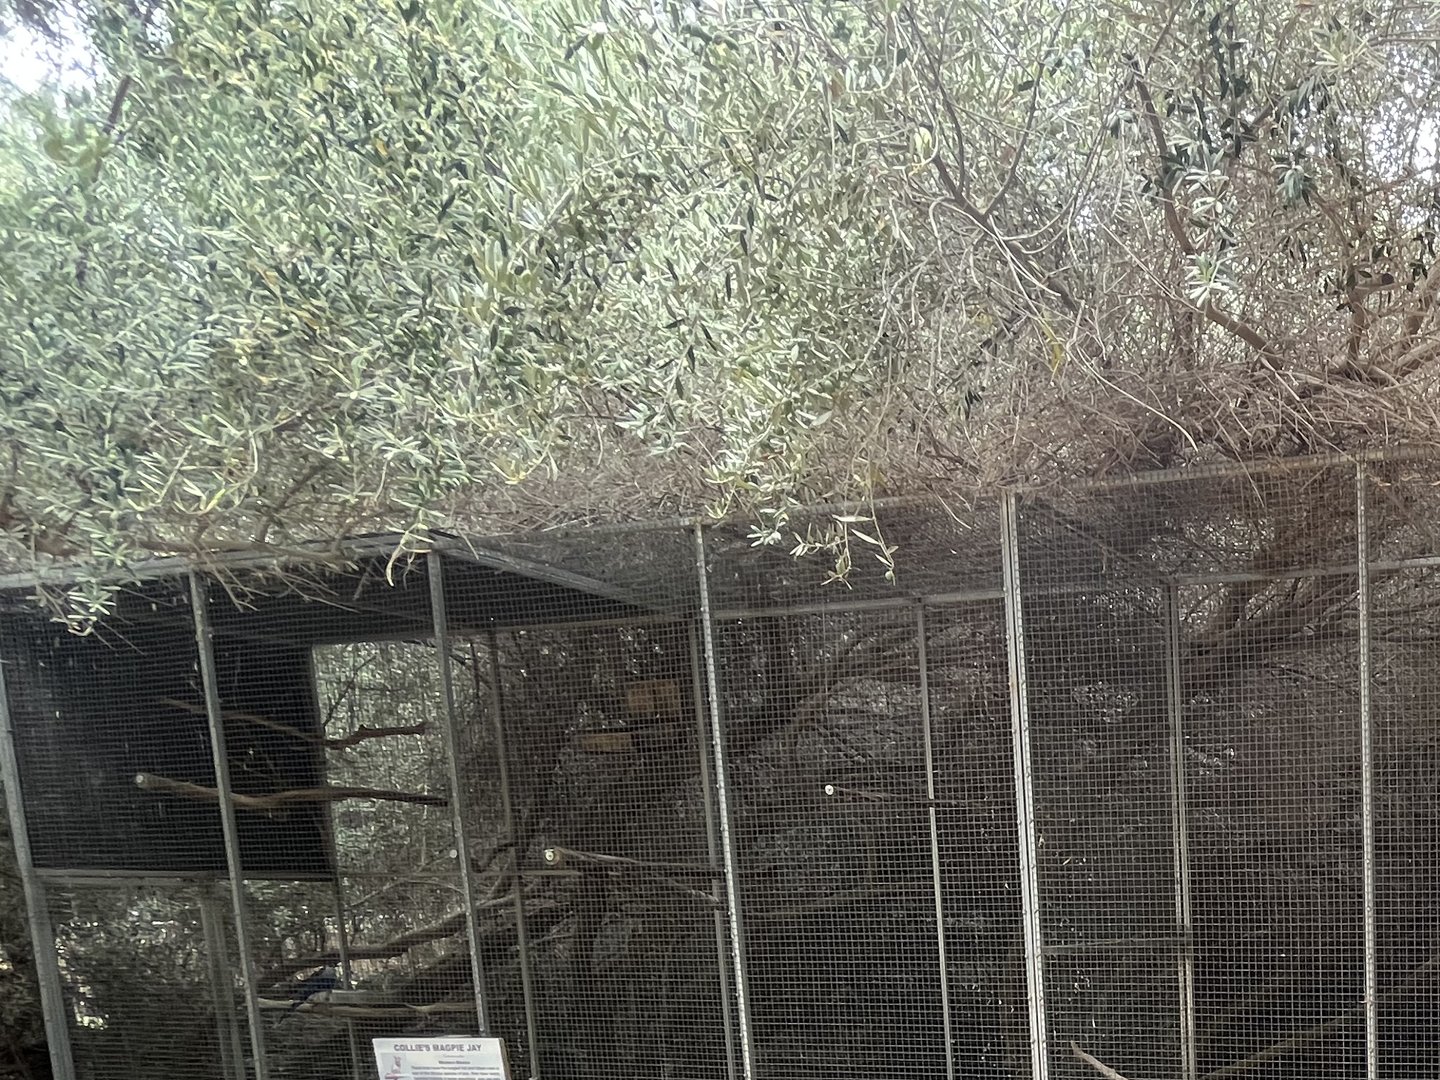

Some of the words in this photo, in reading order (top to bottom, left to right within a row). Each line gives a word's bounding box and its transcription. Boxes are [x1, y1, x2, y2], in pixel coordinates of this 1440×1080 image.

[393, 1044, 431, 1052] COLLIE'S
[432, 1044, 465, 1052] MAGPIE
[466, 1044, 482, 1052] JAY
